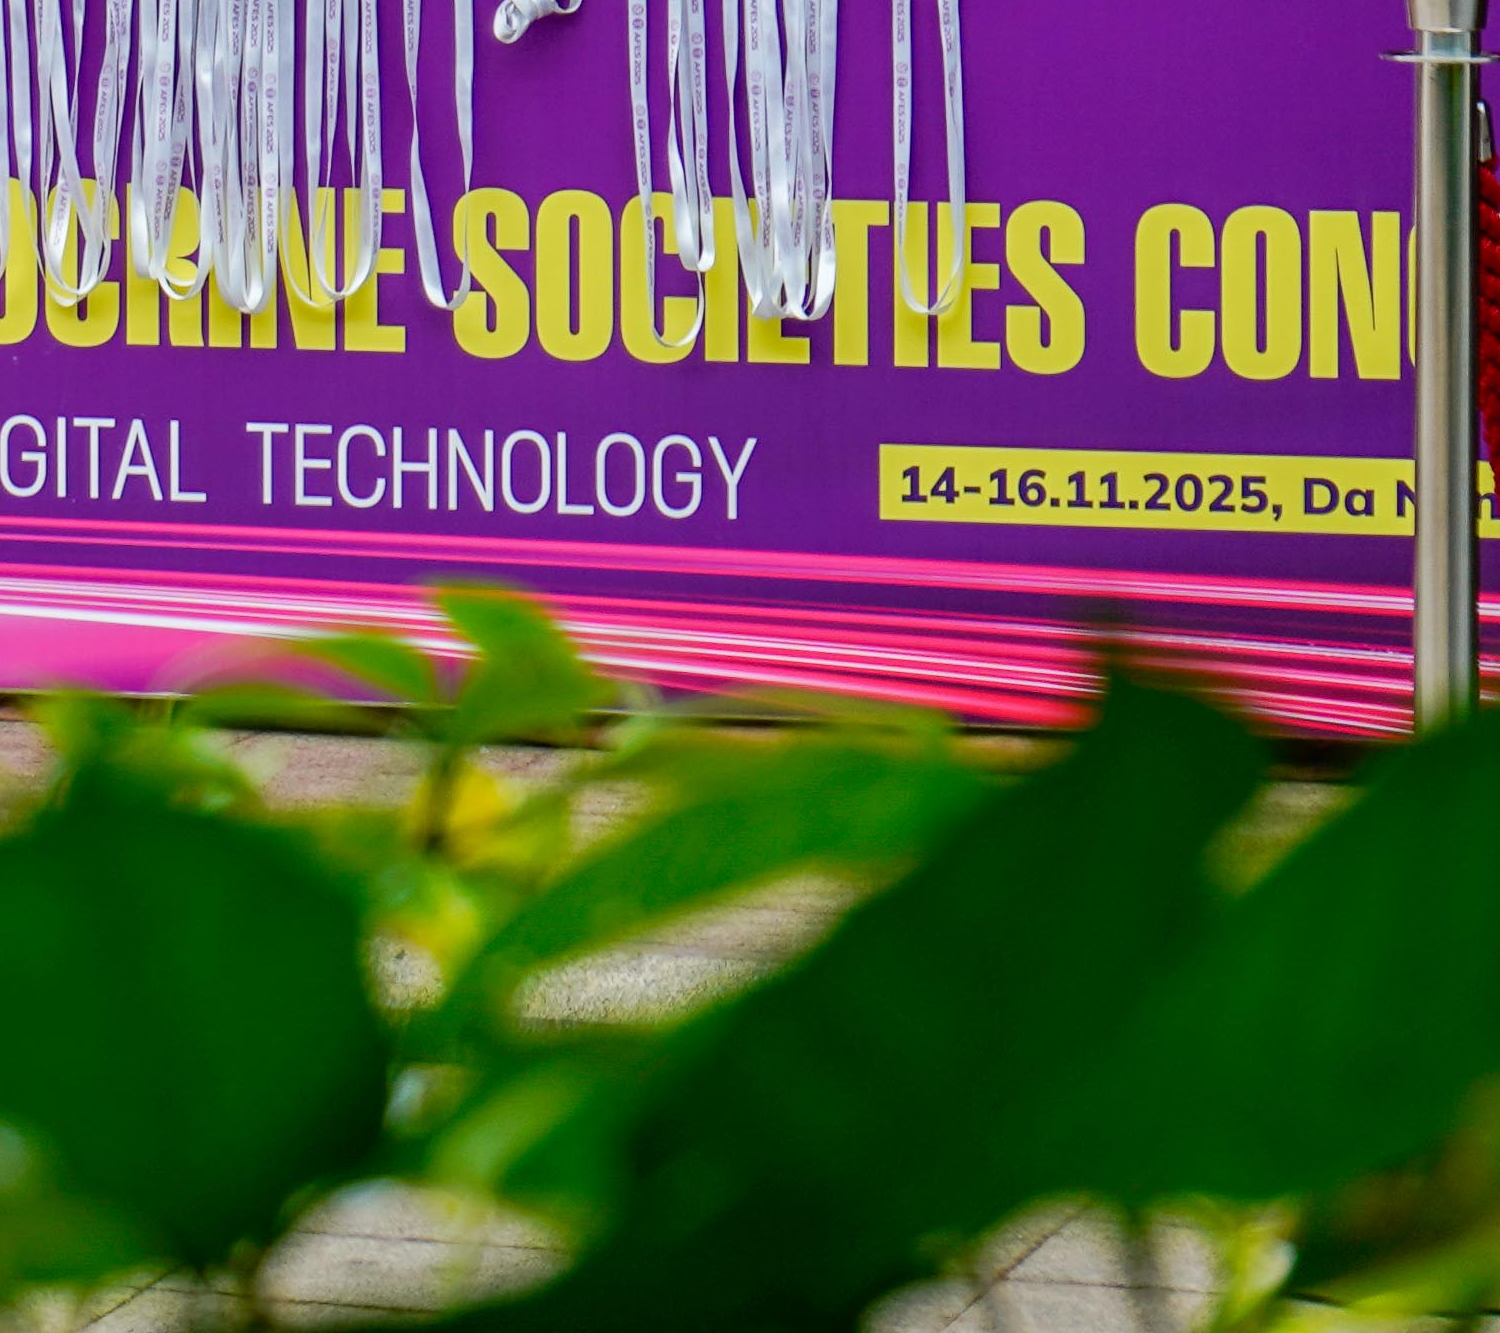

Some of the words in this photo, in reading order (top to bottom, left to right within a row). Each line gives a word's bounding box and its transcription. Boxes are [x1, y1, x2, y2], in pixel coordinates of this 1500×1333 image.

[1134, 202, 1417, 381] CON
[246, 422, 757, 521] TECHNOLOGY
[901, 465, 1283, 522] 14-16.11.2025,
[1304, 477, 1375, 518] Da
